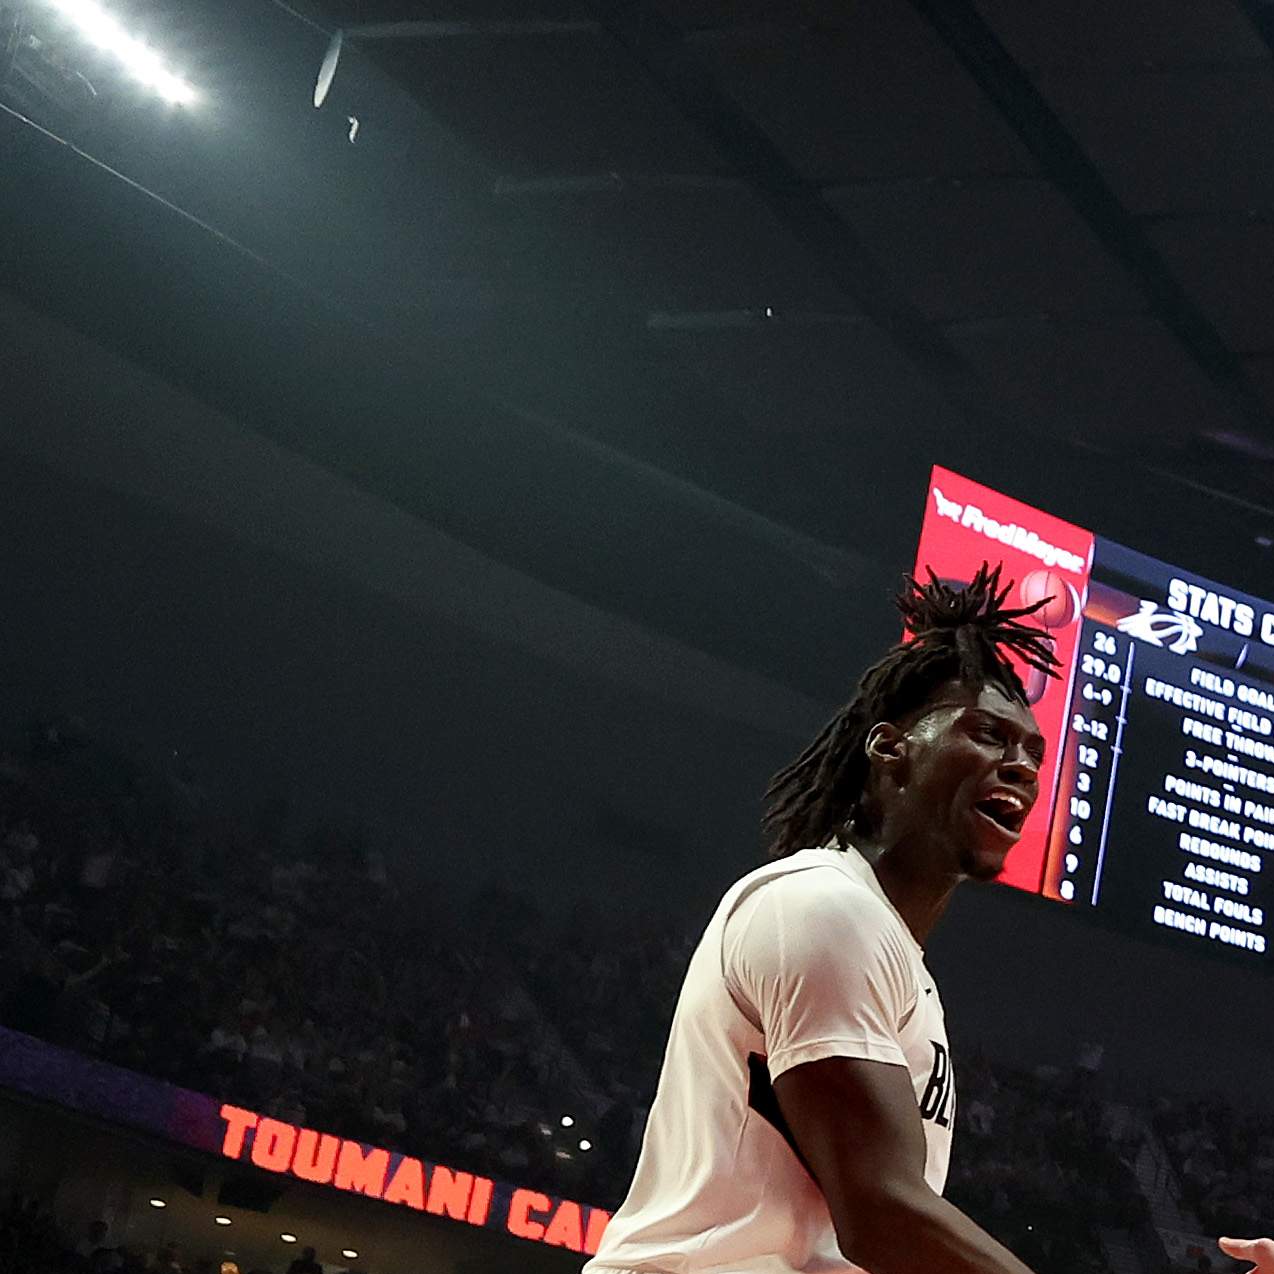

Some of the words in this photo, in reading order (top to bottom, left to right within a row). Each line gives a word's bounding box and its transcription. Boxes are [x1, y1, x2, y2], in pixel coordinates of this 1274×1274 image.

[1168, 579, 1254, 635] STATS
[1191, 668, 1234, 696] FIELD
[1146, 678, 1225, 720] EFFECTIVE
[1228, 707, 1271, 734] FIELD
[1073, 715, 1107, 740] 2-12
[1183, 718, 1223, 745] FREE
[1079, 745, 1098, 767] 12
[1078, 773, 1090, 791] 3
[1165, 775, 1220, 806] POINTS
[1224, 795, 1241, 813] IN
[1071, 797, 1090, 819] 10
[1149, 797, 1186, 822] FAST
[1189, 810, 1240, 840] BREAK
[1180, 833, 1260, 871] REBOUNDS
[1185, 863, 1248, 894] ASSISTS
[1164, 882, 1210, 910] TOTAL
[1214, 897, 1262, 924] FOULS
[1154, 906, 1206, 935] BENCH
[1210, 923, 1265, 952] POINTS
[220, 1103, 493, 1226] TOUMANI
